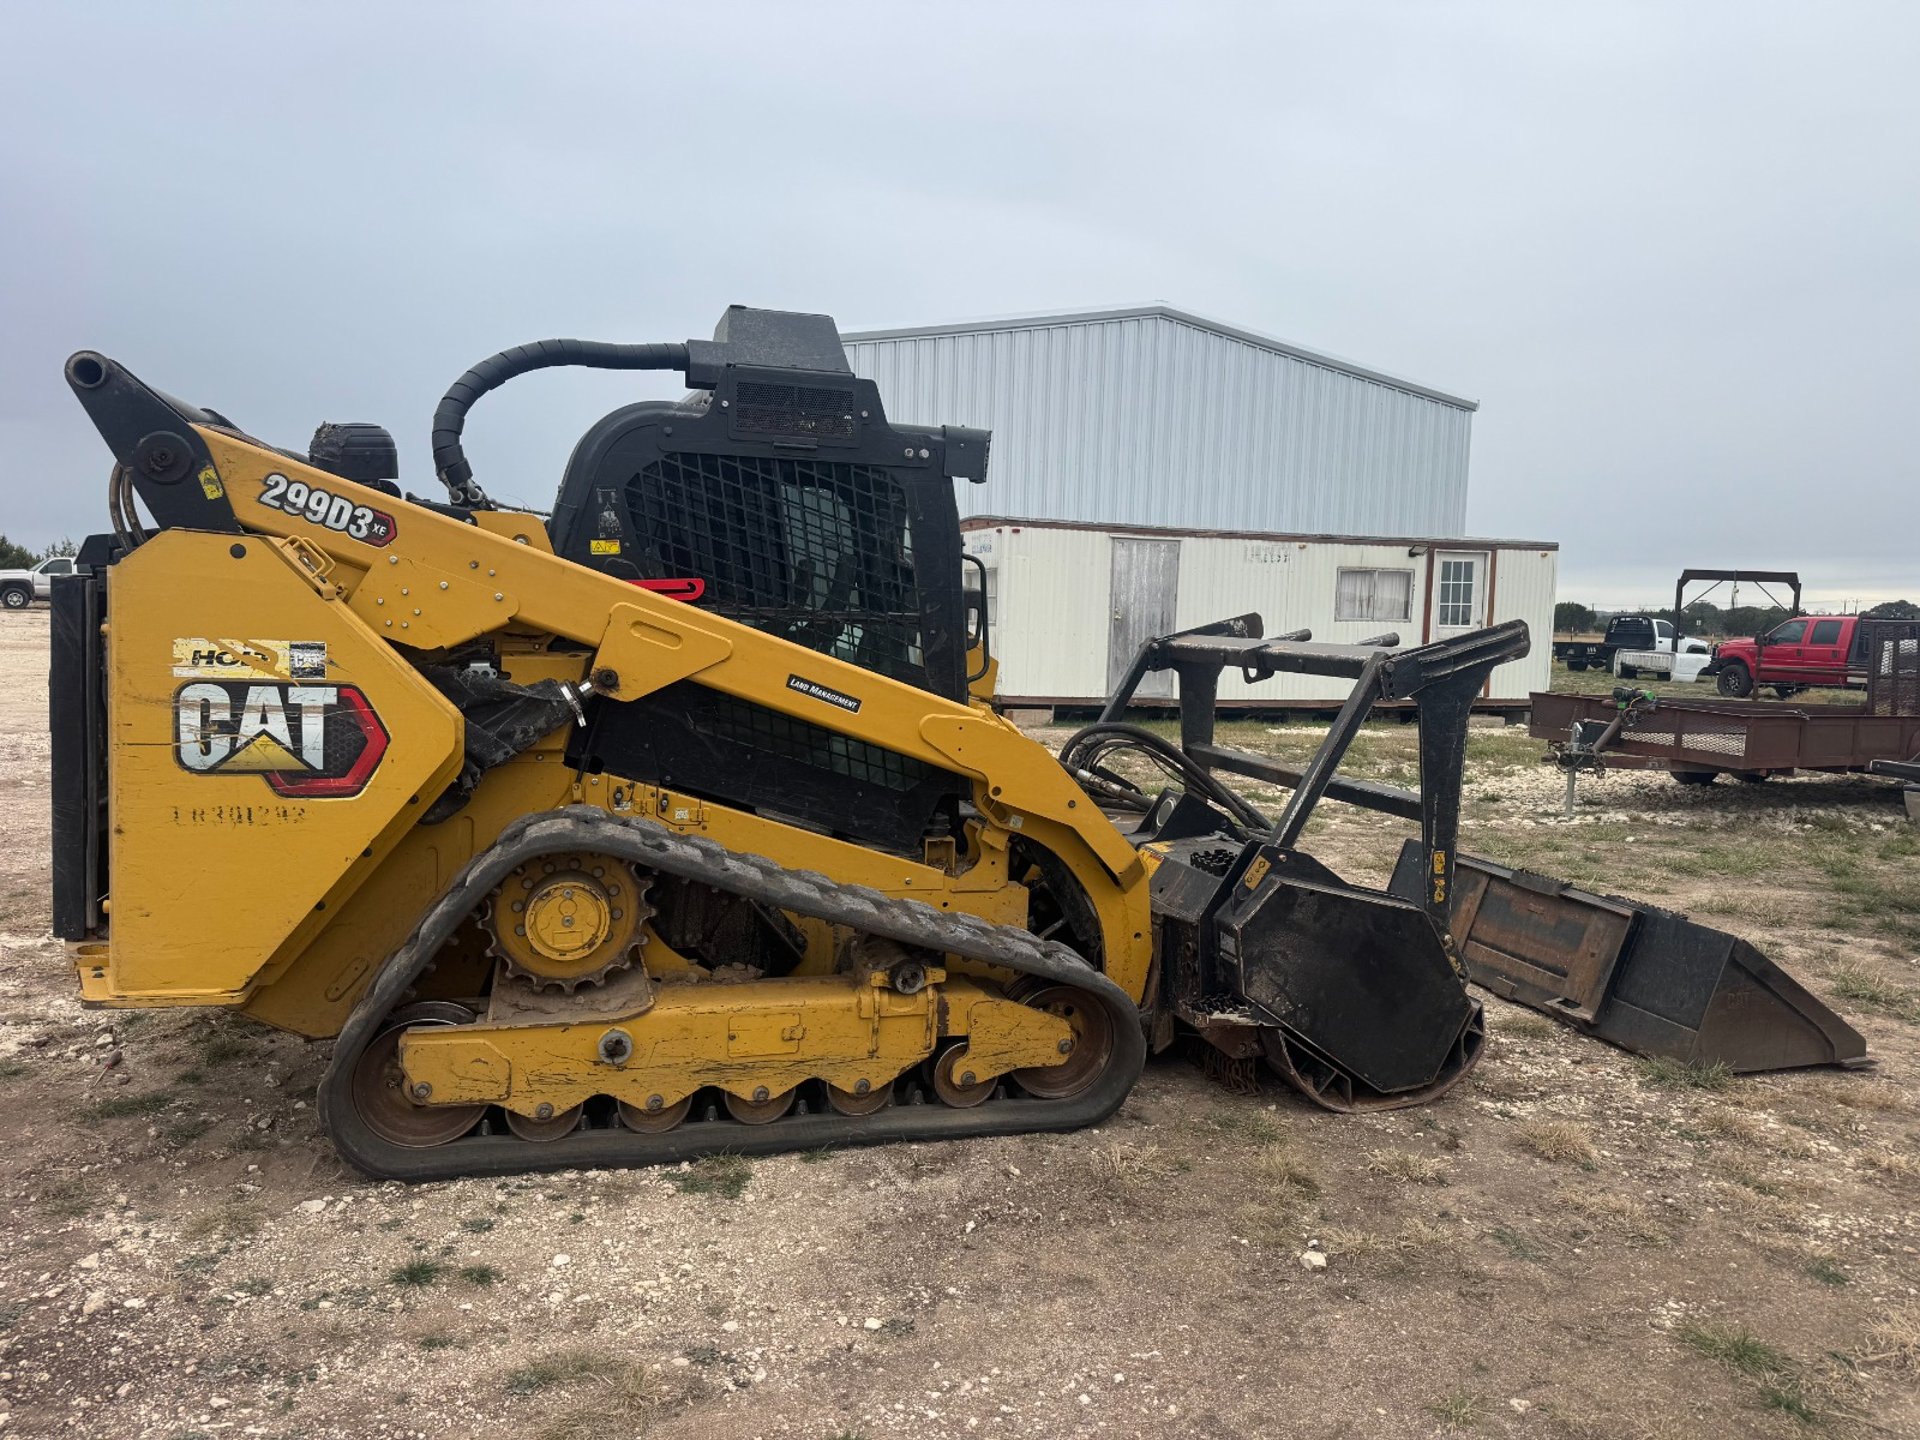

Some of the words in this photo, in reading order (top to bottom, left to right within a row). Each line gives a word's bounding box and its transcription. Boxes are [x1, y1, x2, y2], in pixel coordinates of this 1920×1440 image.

[260, 473, 374, 539] 299D3
[372, 523, 387, 536] XE
[179, 683, 337, 770] CAT
[790, 679, 809, 690] LAND
[810, 687, 858, 708] MANAGEMENT
